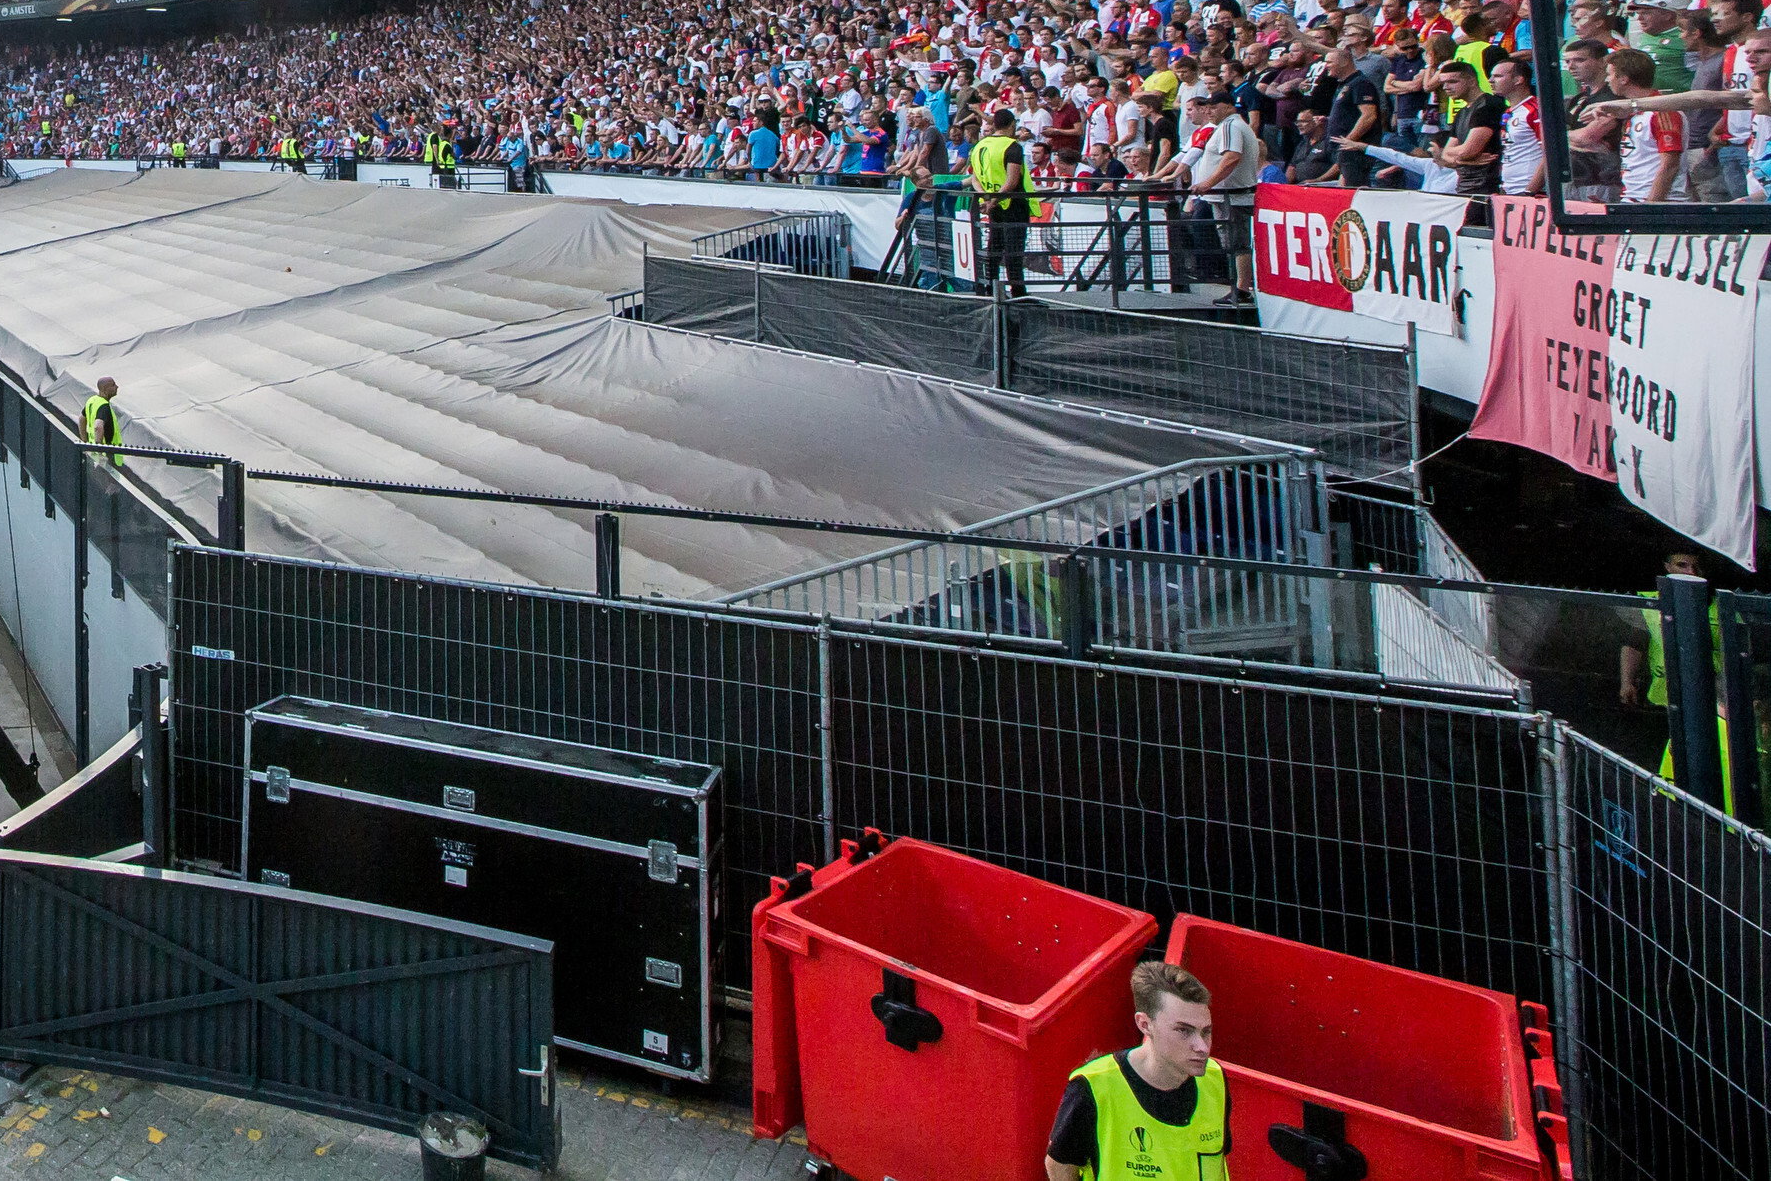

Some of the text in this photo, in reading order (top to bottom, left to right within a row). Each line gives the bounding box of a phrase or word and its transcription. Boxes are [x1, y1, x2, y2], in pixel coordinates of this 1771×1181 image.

[9, 5, 36, 16] AMSTEL
[957, 232, 969, 269] U
[1258, 208, 1333, 284] TER
[1374, 220, 1451, 305] AAR
[1573, 280, 1651, 349] GROET
[194, 647, 231, 659] HERAS
[653, 1035, 659, 1044] 5
[1126, 1160, 1163, 1173] EUROPA
